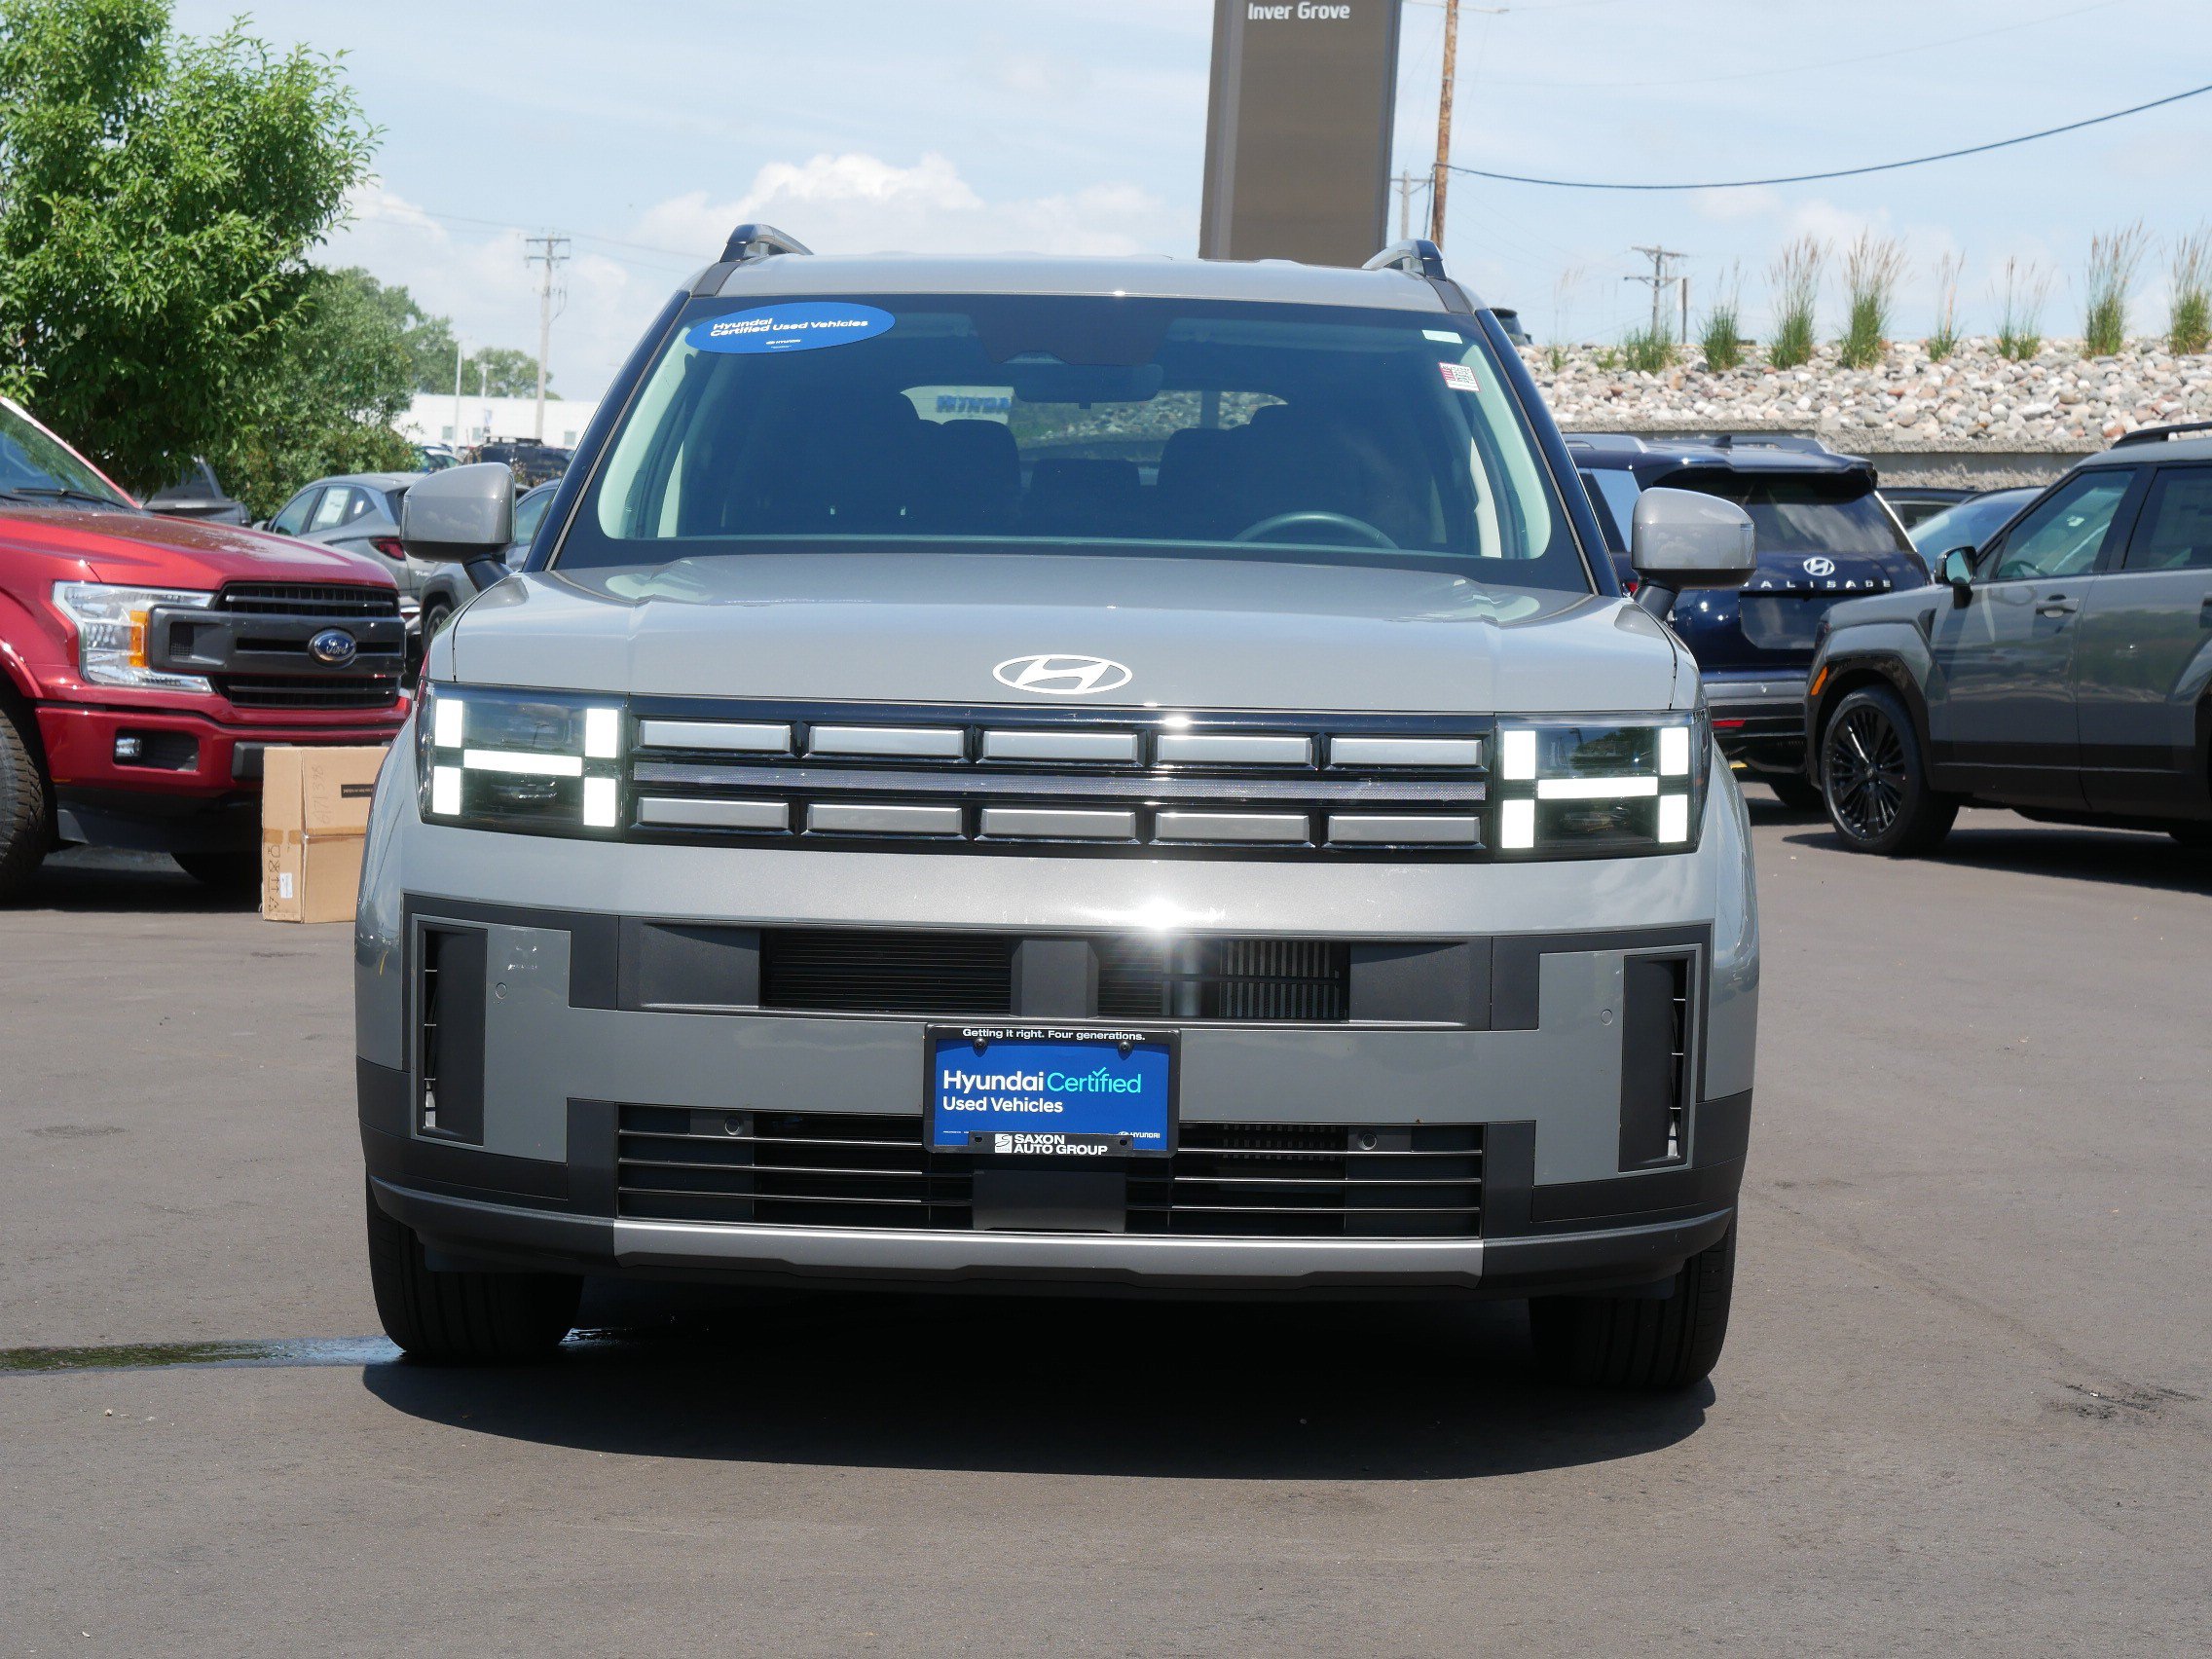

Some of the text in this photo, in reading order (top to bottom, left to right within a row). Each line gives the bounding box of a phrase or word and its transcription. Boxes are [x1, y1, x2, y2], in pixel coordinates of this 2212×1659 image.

[1248, 1, 1351, 19] Inver Grove
[710, 318, 868, 337] Certified Used Vehicles
[713, 317, 773, 331] Hyundai
[1742, 579, 1892, 589] ALISADE
[963, 1028, 1146, 1041] Getting it right. Four generations.
[942, 1067, 1142, 1094] Hyundai Certified
[942, 1096, 1063, 1113] Used Vehicles
[1014, 1134, 1065, 1145] SAXON
[1014, 1144, 1053, 1155] AUTO
[1055, 1144, 1108, 1156] GROUP
